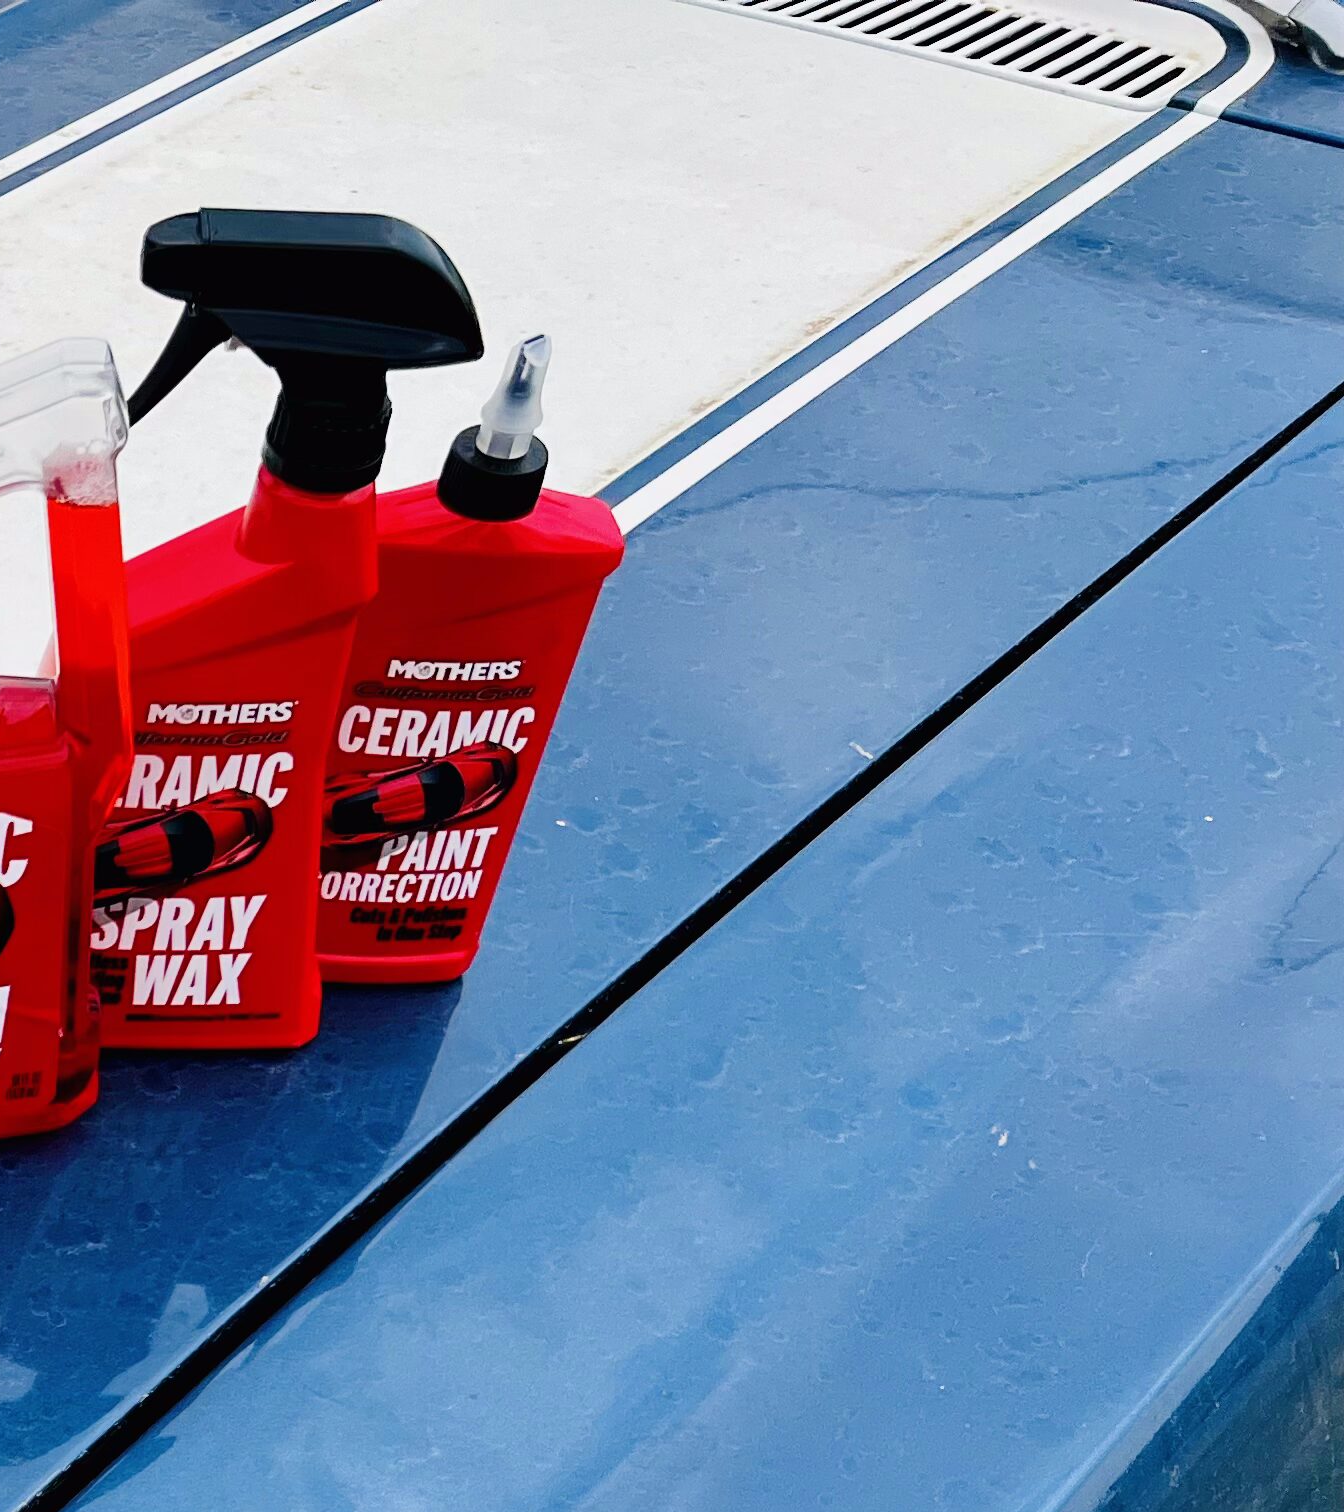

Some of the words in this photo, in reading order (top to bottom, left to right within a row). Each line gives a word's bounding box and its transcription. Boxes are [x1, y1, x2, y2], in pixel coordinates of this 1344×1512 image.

[386, 659, 522, 682] MOTHERS
[353, 681, 475, 700] California
[476, 685, 535, 702] Gold
[147, 702, 294, 725] MOTHERS
[338, 705, 536, 757] CERAMIC
[222, 728, 288, 748] Gold
[114, 752, 294, 809] RAMIC
[377, 827, 499, 872] PAINT
[318, 869, 483, 903] ORRECTION
[90, 894, 268, 952] SPRAY
[132, 953, 252, 1006] WAX
